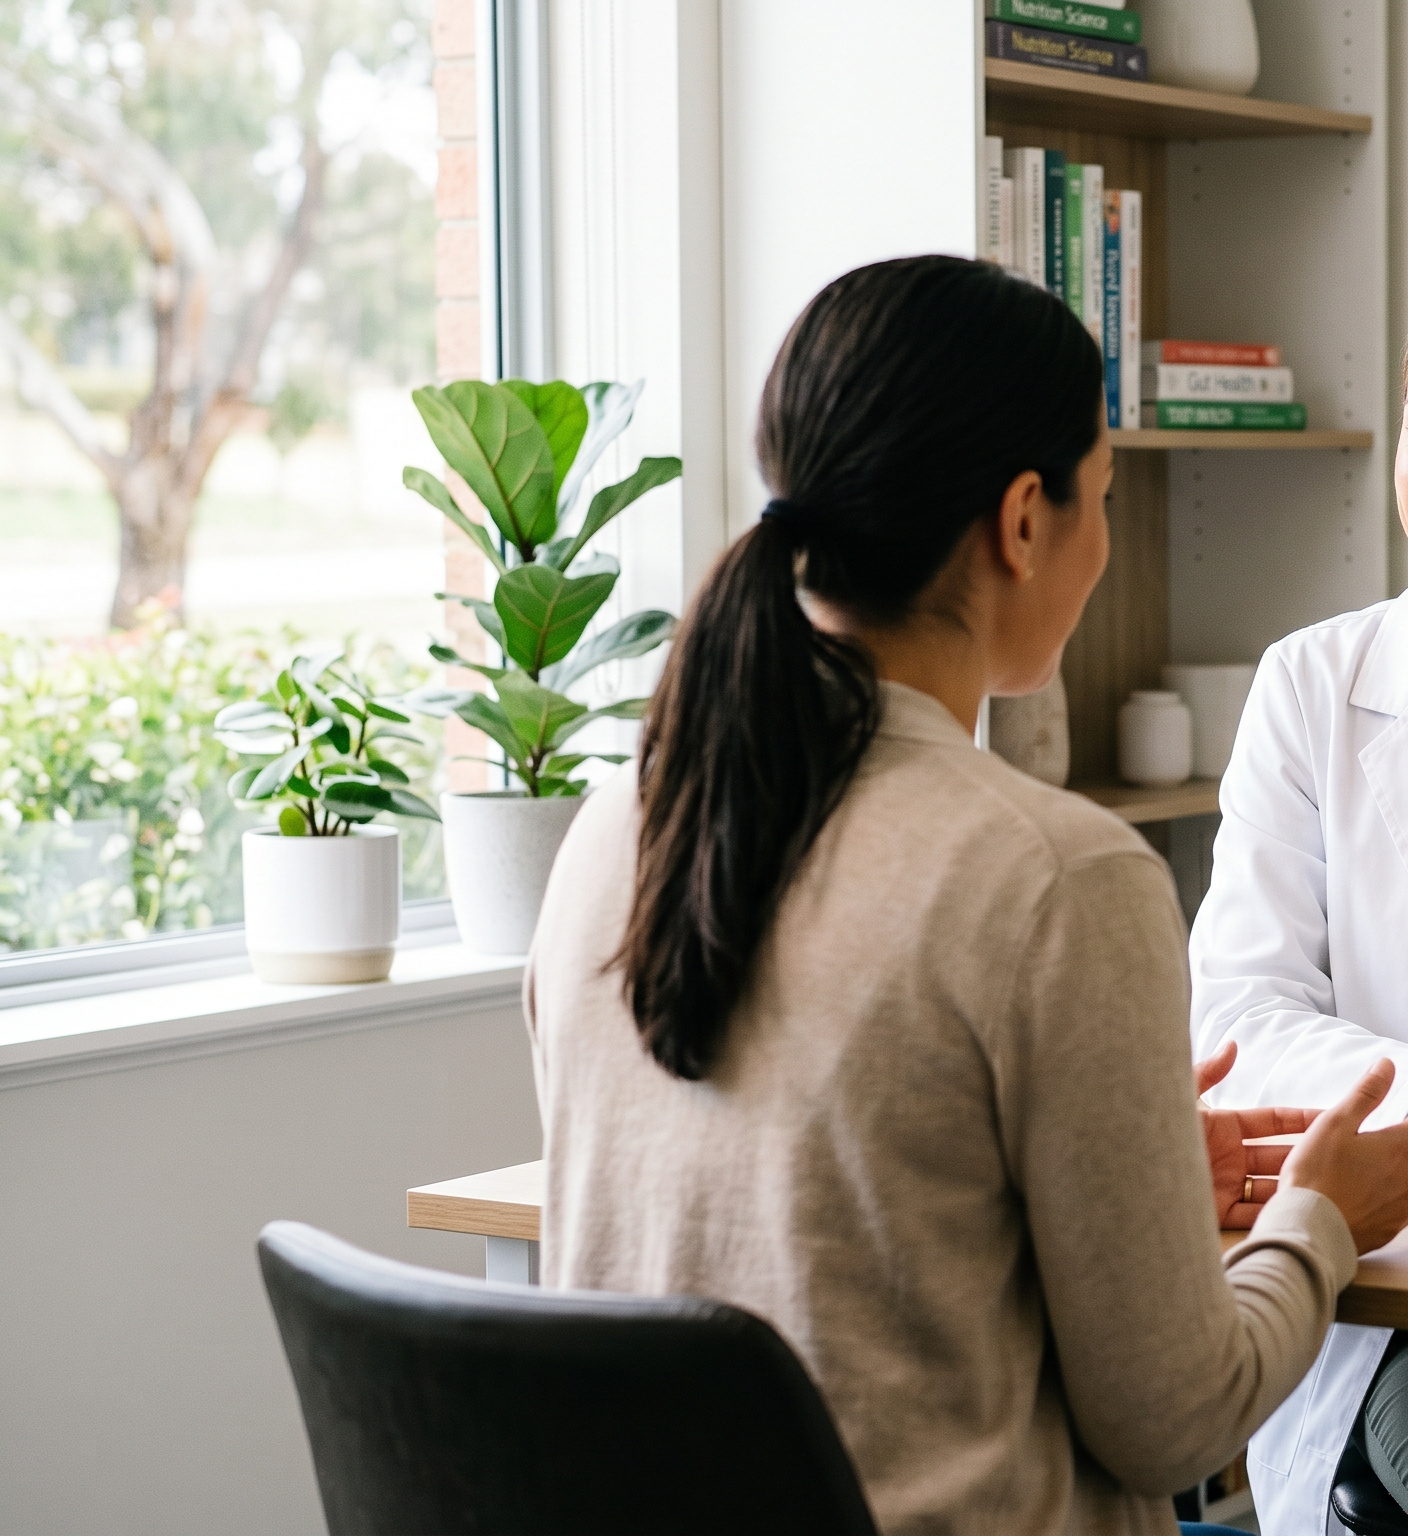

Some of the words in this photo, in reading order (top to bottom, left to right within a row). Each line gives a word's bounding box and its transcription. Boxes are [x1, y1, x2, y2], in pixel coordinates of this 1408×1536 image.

[1012, 0, 1063, 22] Nutrition
[1065, 5, 1109, 31] Science
[1012, 30, 1067, 57] Nutrition
[1067, 40, 1114, 67] Science
